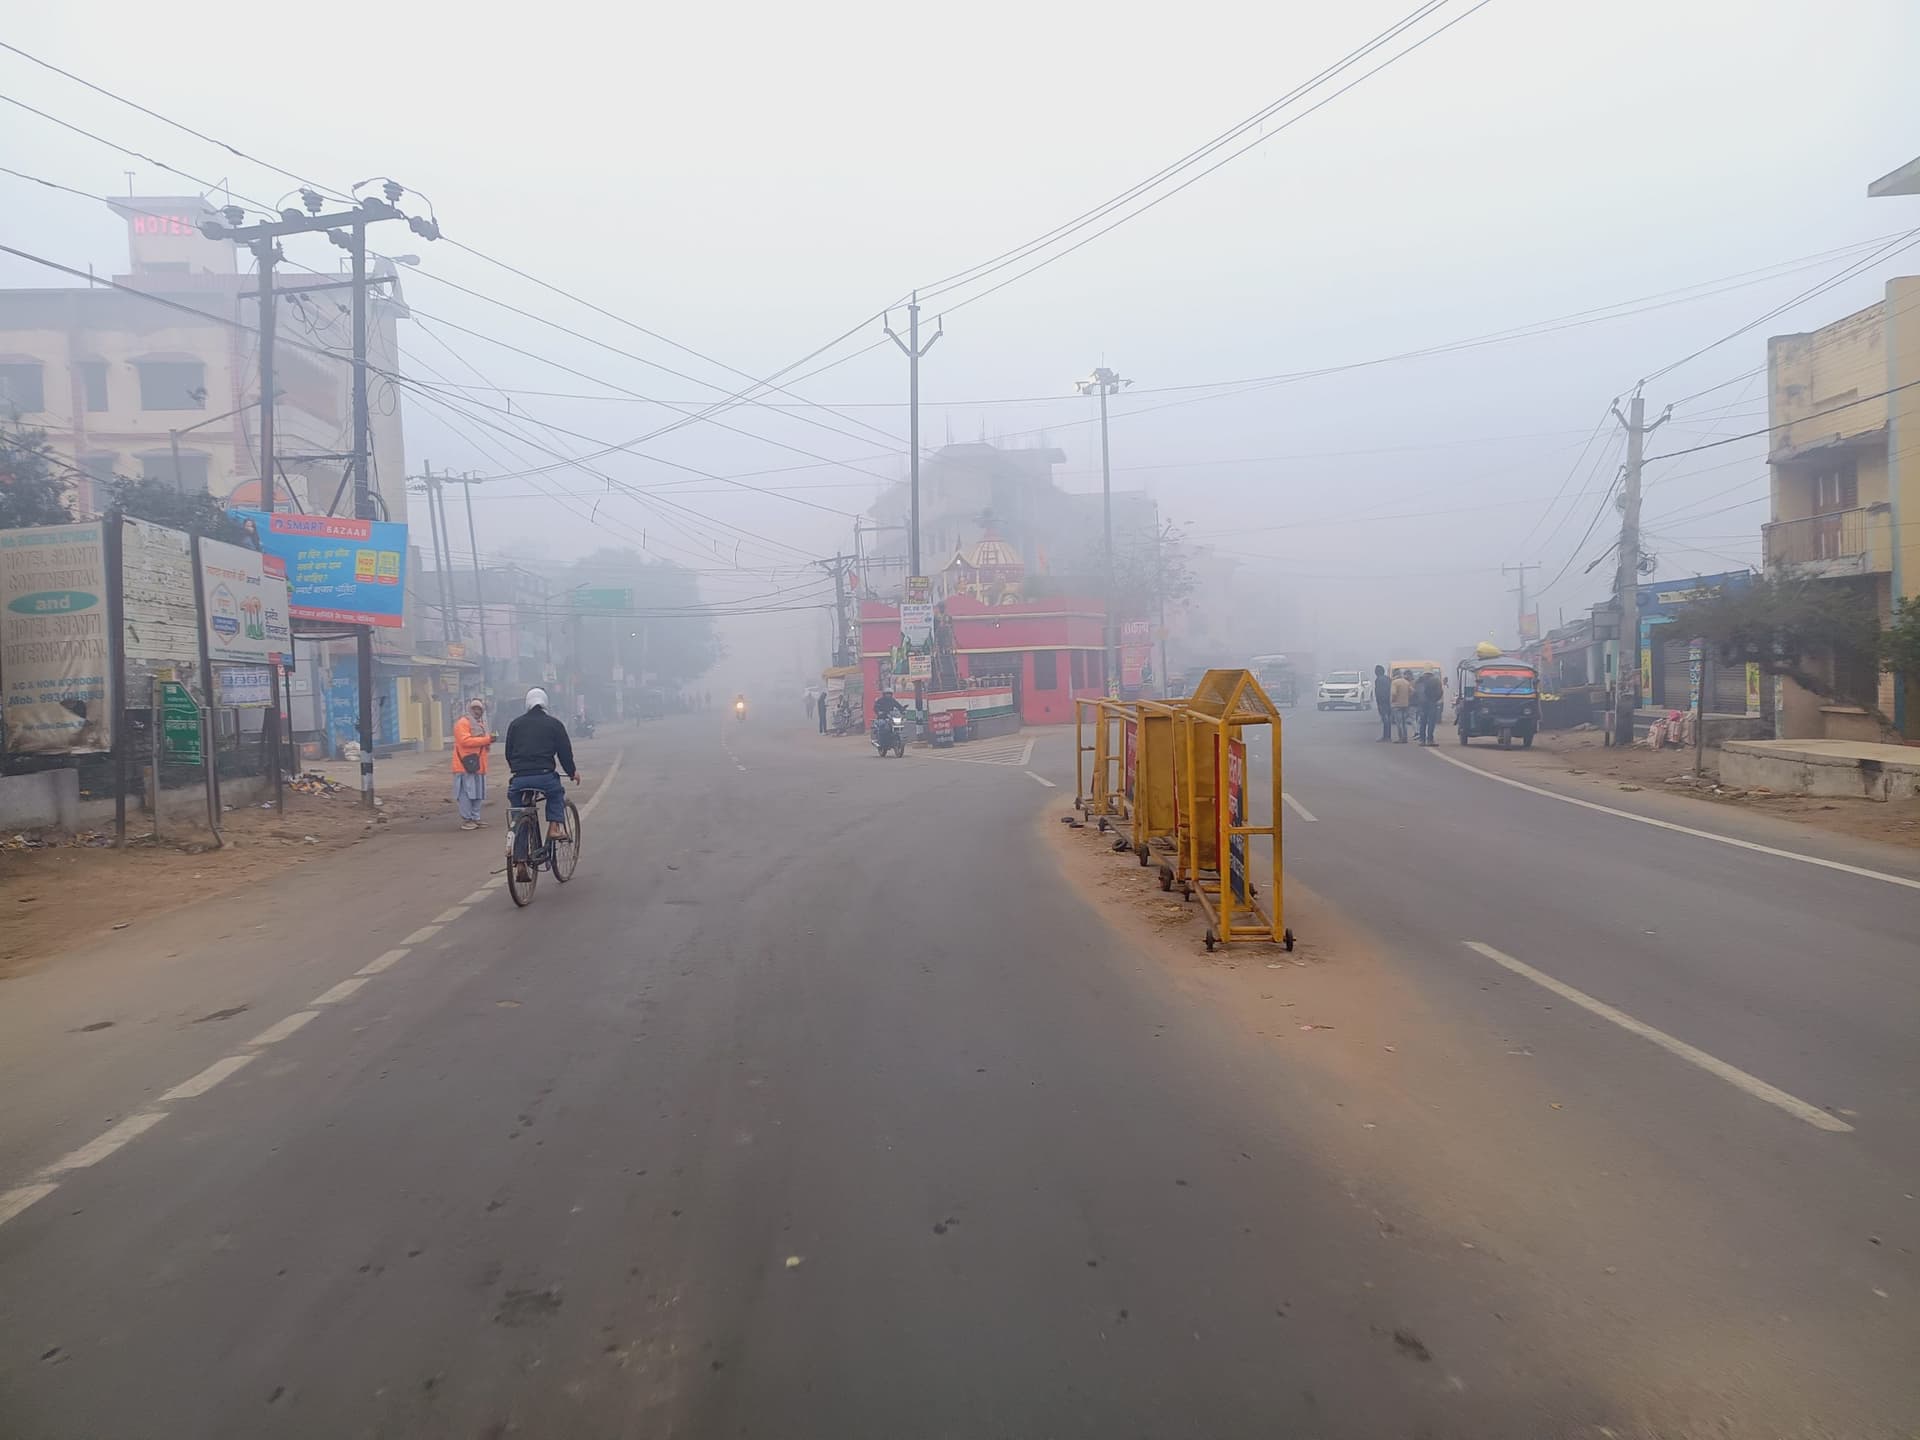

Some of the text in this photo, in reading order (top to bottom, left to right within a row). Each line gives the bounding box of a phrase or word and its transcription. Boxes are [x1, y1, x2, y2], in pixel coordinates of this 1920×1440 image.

[135, 216, 192, 233] HOTEL
[287, 519, 324, 531] SMART
[327, 527, 367, 536] BAZAAR
[6, 546, 98, 570] HOTEL SHANTI
[35, 595, 70, 609] and
[8, 613, 101, 639] HOTEL SHANTI
[5, 639, 106, 665] INTERNATIONAL
[37, 679, 56, 689] NON
